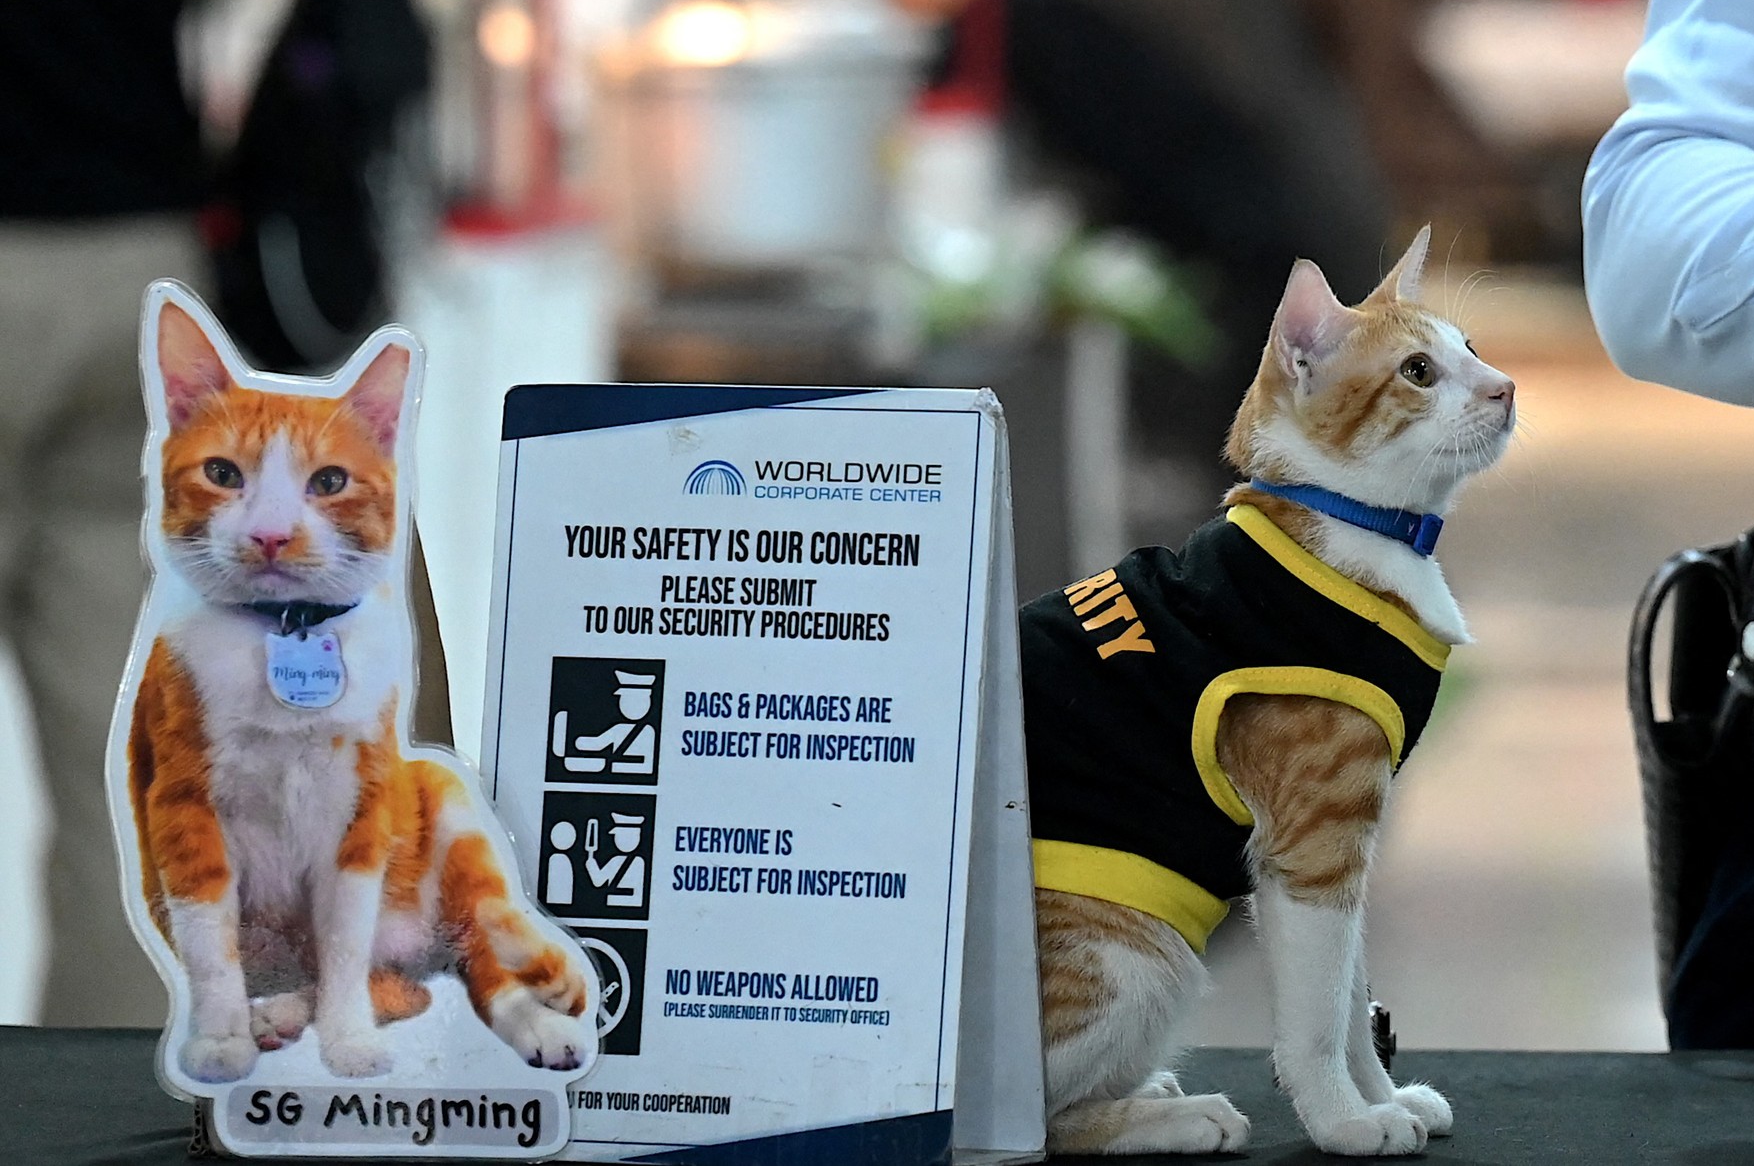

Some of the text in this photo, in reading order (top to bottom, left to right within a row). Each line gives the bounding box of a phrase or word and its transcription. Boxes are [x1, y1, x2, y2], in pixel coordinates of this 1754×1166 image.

[754, 460, 943, 485] WORLDWIDE
[754, 485, 942, 503] CORPORATE CENTER
[564, 525, 920, 566] YOUR SAFETY IS OUR CONCERN
[660, 575, 817, 606] PLEASE SUBMIT
[583, 605, 890, 641] TO OUR SECURITY PROCEDURES
[683, 691, 893, 723] BAGS & PACKAGES ARE
[681, 730, 915, 763] SUBJECT FOR INSPECTION
[675, 826, 793, 856] EVERYONE IS
[672, 865, 907, 899] SUBJECT FOR INSPECTION
[665, 969, 879, 1002] NO WEAPONS ALLOWED
[708, 1004, 769, 1021] SURRENDER
[771, 1006, 782, 1021] IT
[784, 1007, 797, 1022] TO
[798, 1007, 849, 1024] SECURITY
[245, 1090, 304, 1125] SG
[323, 1093, 542, 1147] Mingming
[578, 1091, 602, 1110] FOR
[606, 1092, 640, 1111] YOUR
[643, 1093, 732, 1115] COOPERATION
